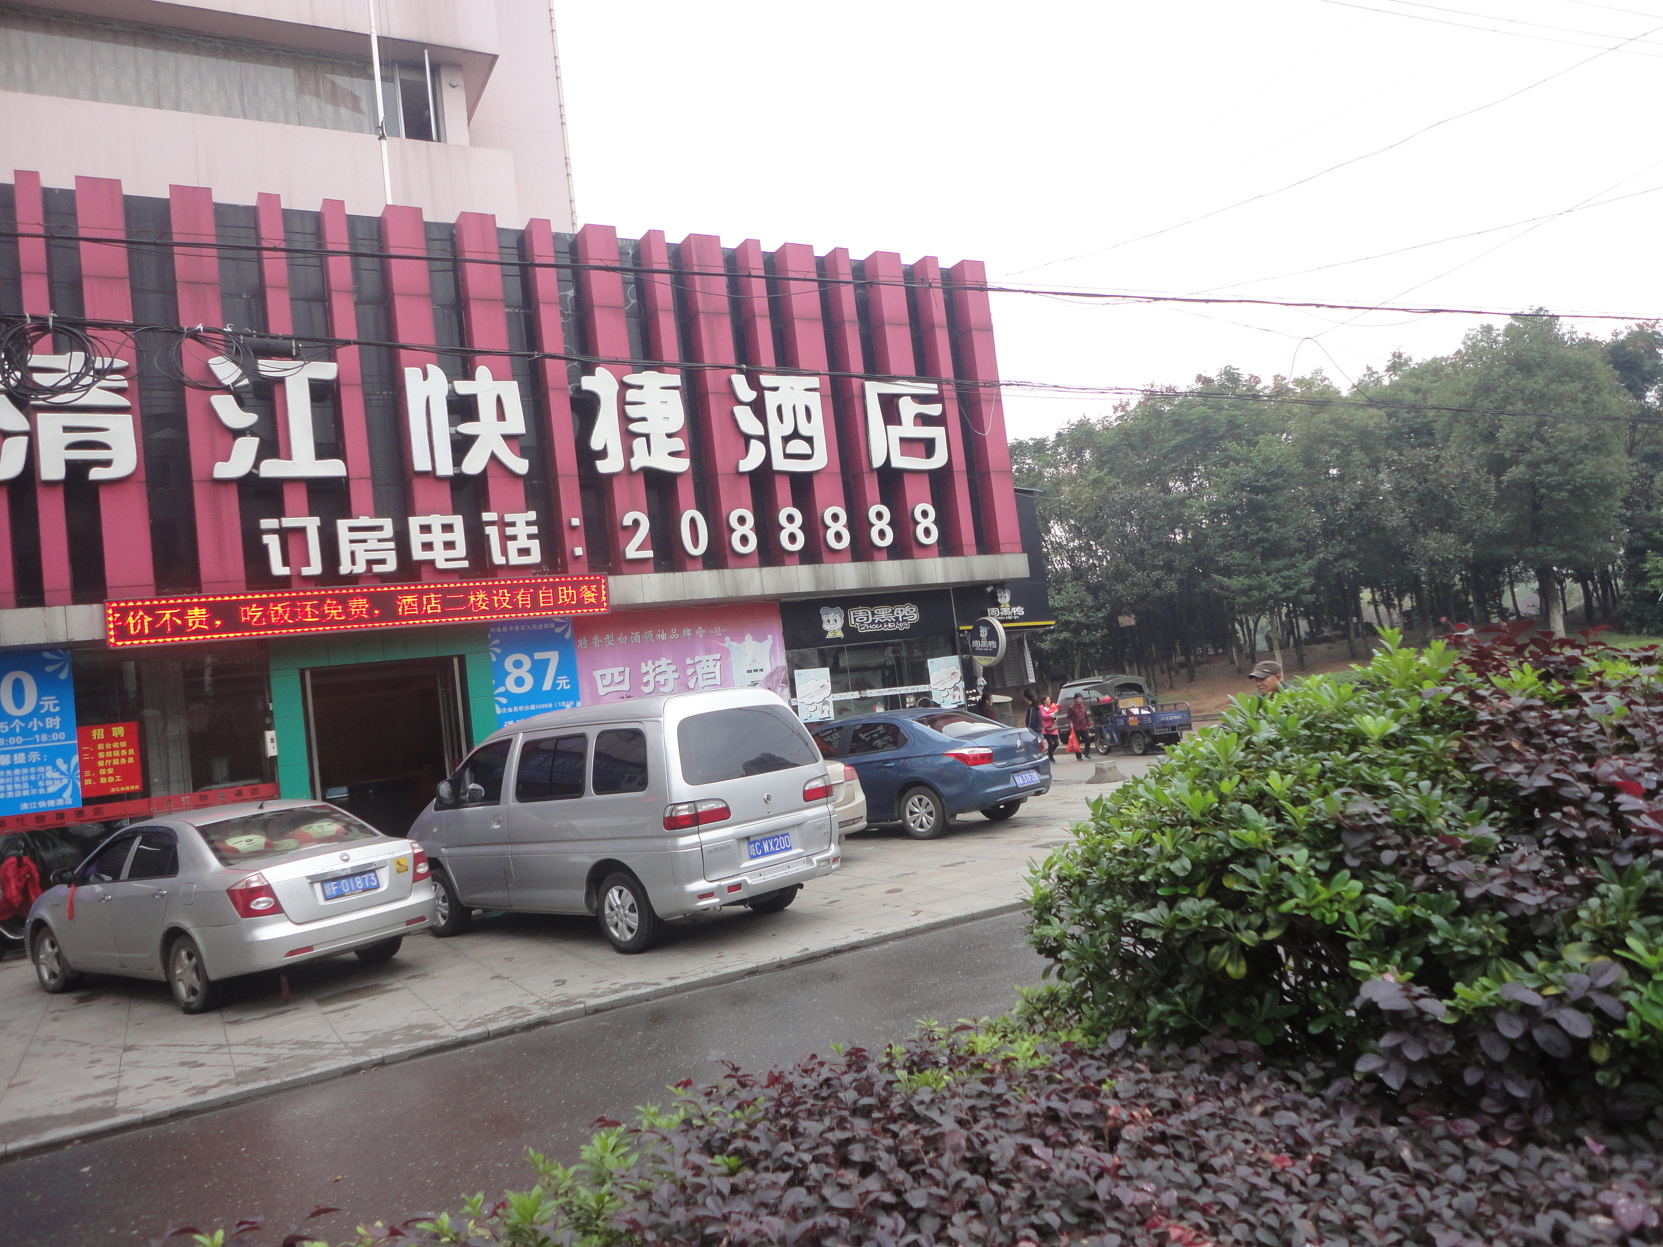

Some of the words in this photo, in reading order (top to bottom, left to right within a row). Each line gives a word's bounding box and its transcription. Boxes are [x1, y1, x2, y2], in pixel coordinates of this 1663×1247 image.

[0, 352, 949, 481] 清江快捷酒店
[849, 604, 919, 627] 周黑鸭
[593, 653, 722, 696] 四特酒
[91, 726, 125, 740] 招聘
